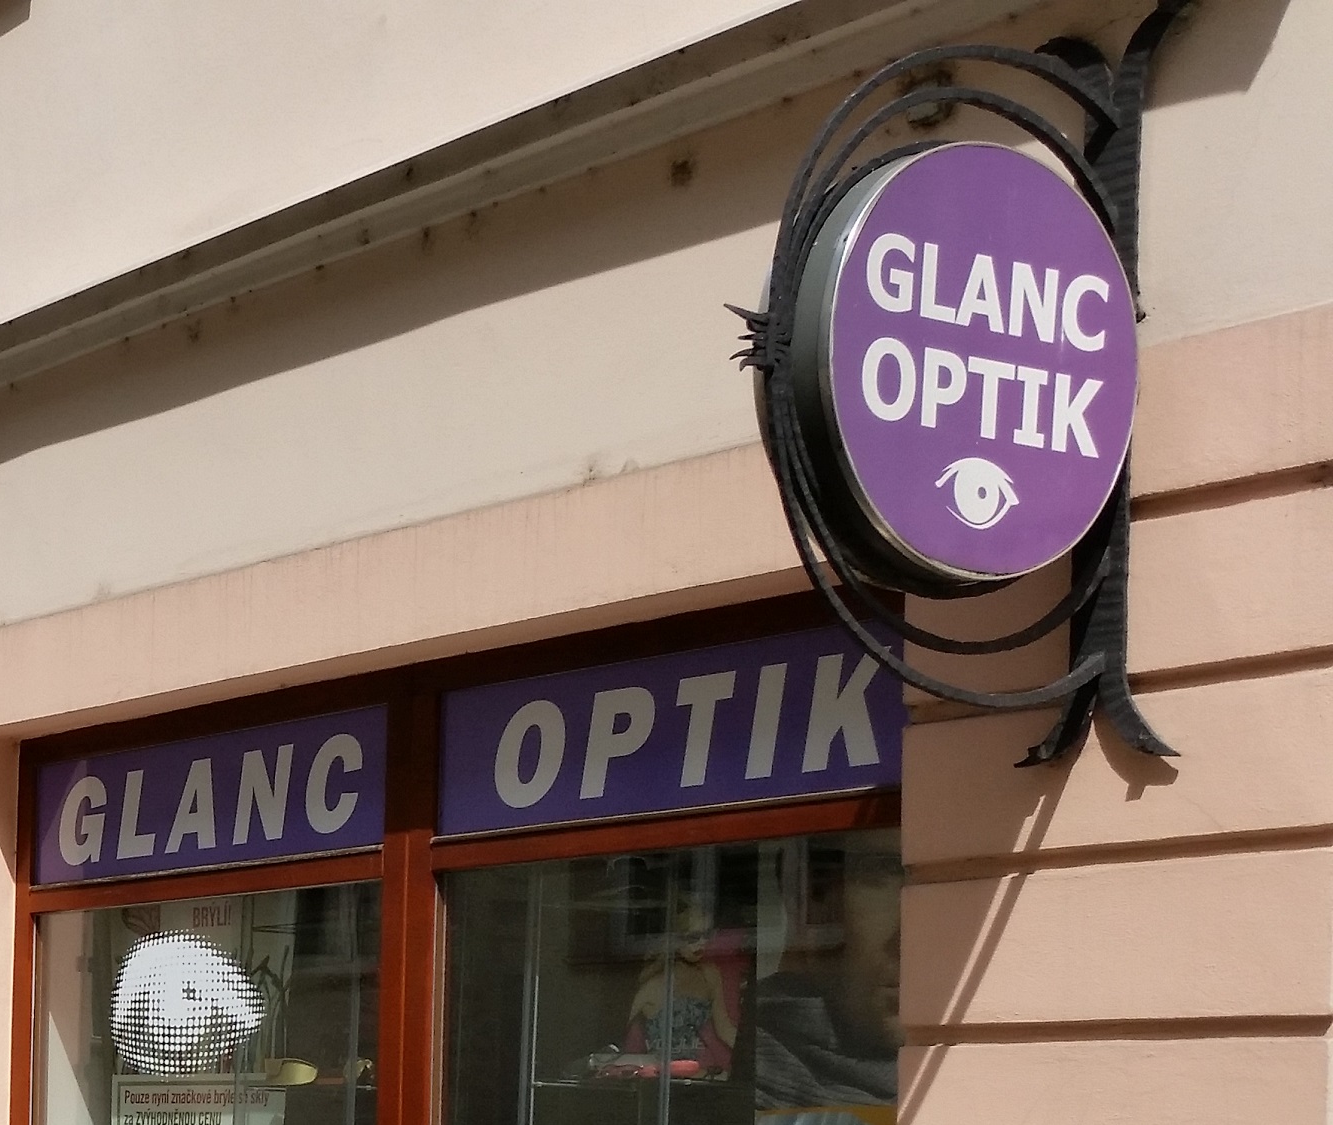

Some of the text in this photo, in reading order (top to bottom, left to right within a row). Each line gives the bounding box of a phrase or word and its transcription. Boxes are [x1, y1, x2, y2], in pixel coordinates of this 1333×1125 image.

[865, 232, 1110, 353] GLANC
[860, 336, 1104, 459] OPTIK
[58, 645, 892, 867] GLANC OPTIK
[192, 900, 232, 928] BRÝLÍ!
[123, 1114, 134, 1125] za
[124, 1089, 150, 1105] Pouze
[151, 1089, 170, 1107] nyní
[171, 1088, 212, 1105] značkové
